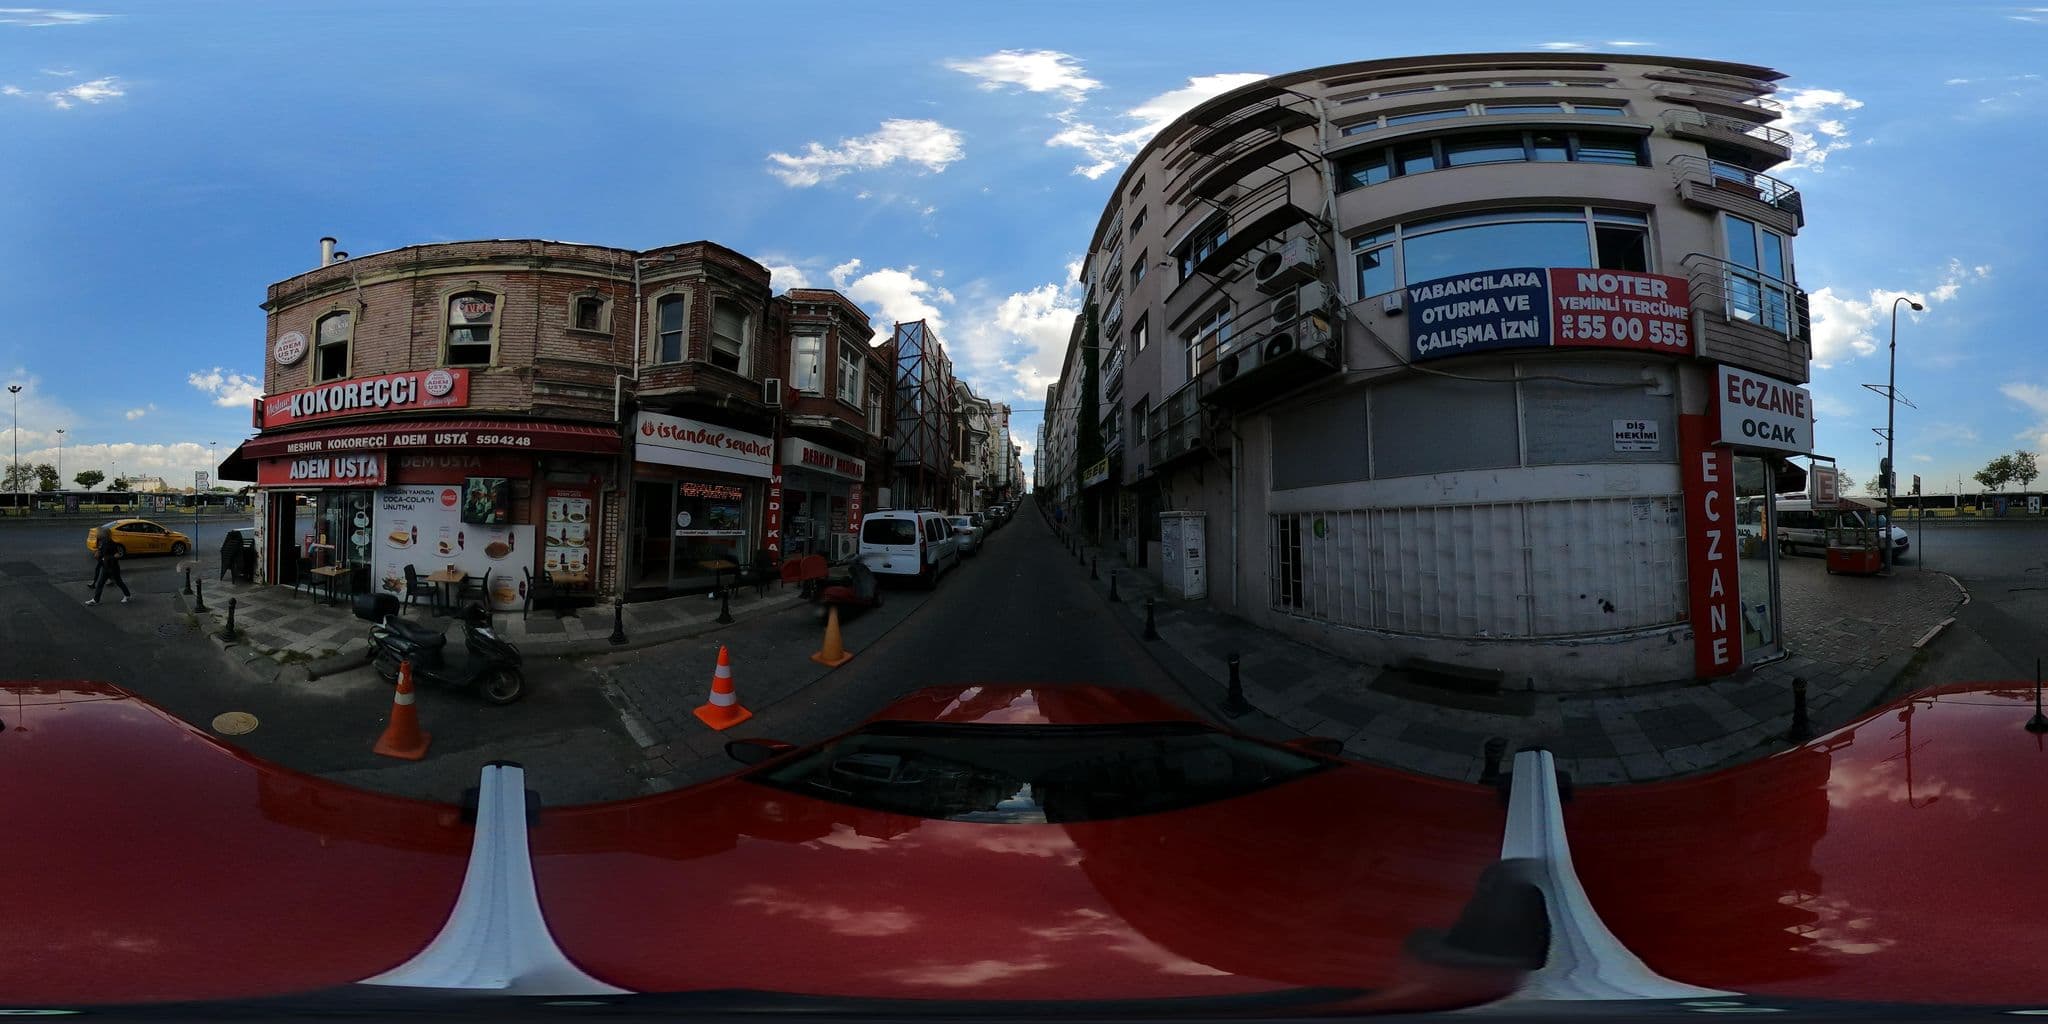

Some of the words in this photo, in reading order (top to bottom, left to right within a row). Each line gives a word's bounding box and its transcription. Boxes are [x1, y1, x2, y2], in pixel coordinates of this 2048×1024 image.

[1409, 272, 1542, 304] YABANCILARA
[1577, 272, 1669, 299] NOTER
[1421, 298, 1499, 325] OTURMA
[1503, 295, 1531, 312] VE
[1558, 294, 1621, 312] YEMİNLİ
[1623, 298, 1690, 321] TERCÜME
[1416, 323, 1498, 355] ÇALIŞMA
[1501, 315, 1540, 341] İZNİ
[1562, 314, 1575, 340] 216
[1577, 314, 1607, 340] 55
[1612, 316, 1645, 343] 00
[1649, 321, 1689, 348] 555
[1727, 372, 1805, 419] ECZANE
[1615, 431, 1657, 440] HEKİMİ
[1626, 421, 1646, 432] DİŞ
[1741, 418, 1797, 444] OCAK
[288, 441, 323, 453] MESHUR
[393, 434, 427, 446] ADEM
[289, 459, 330, 480] ADEM
[335, 455, 380, 478] USTA
[1702, 452, 1729, 666] ECZANE
